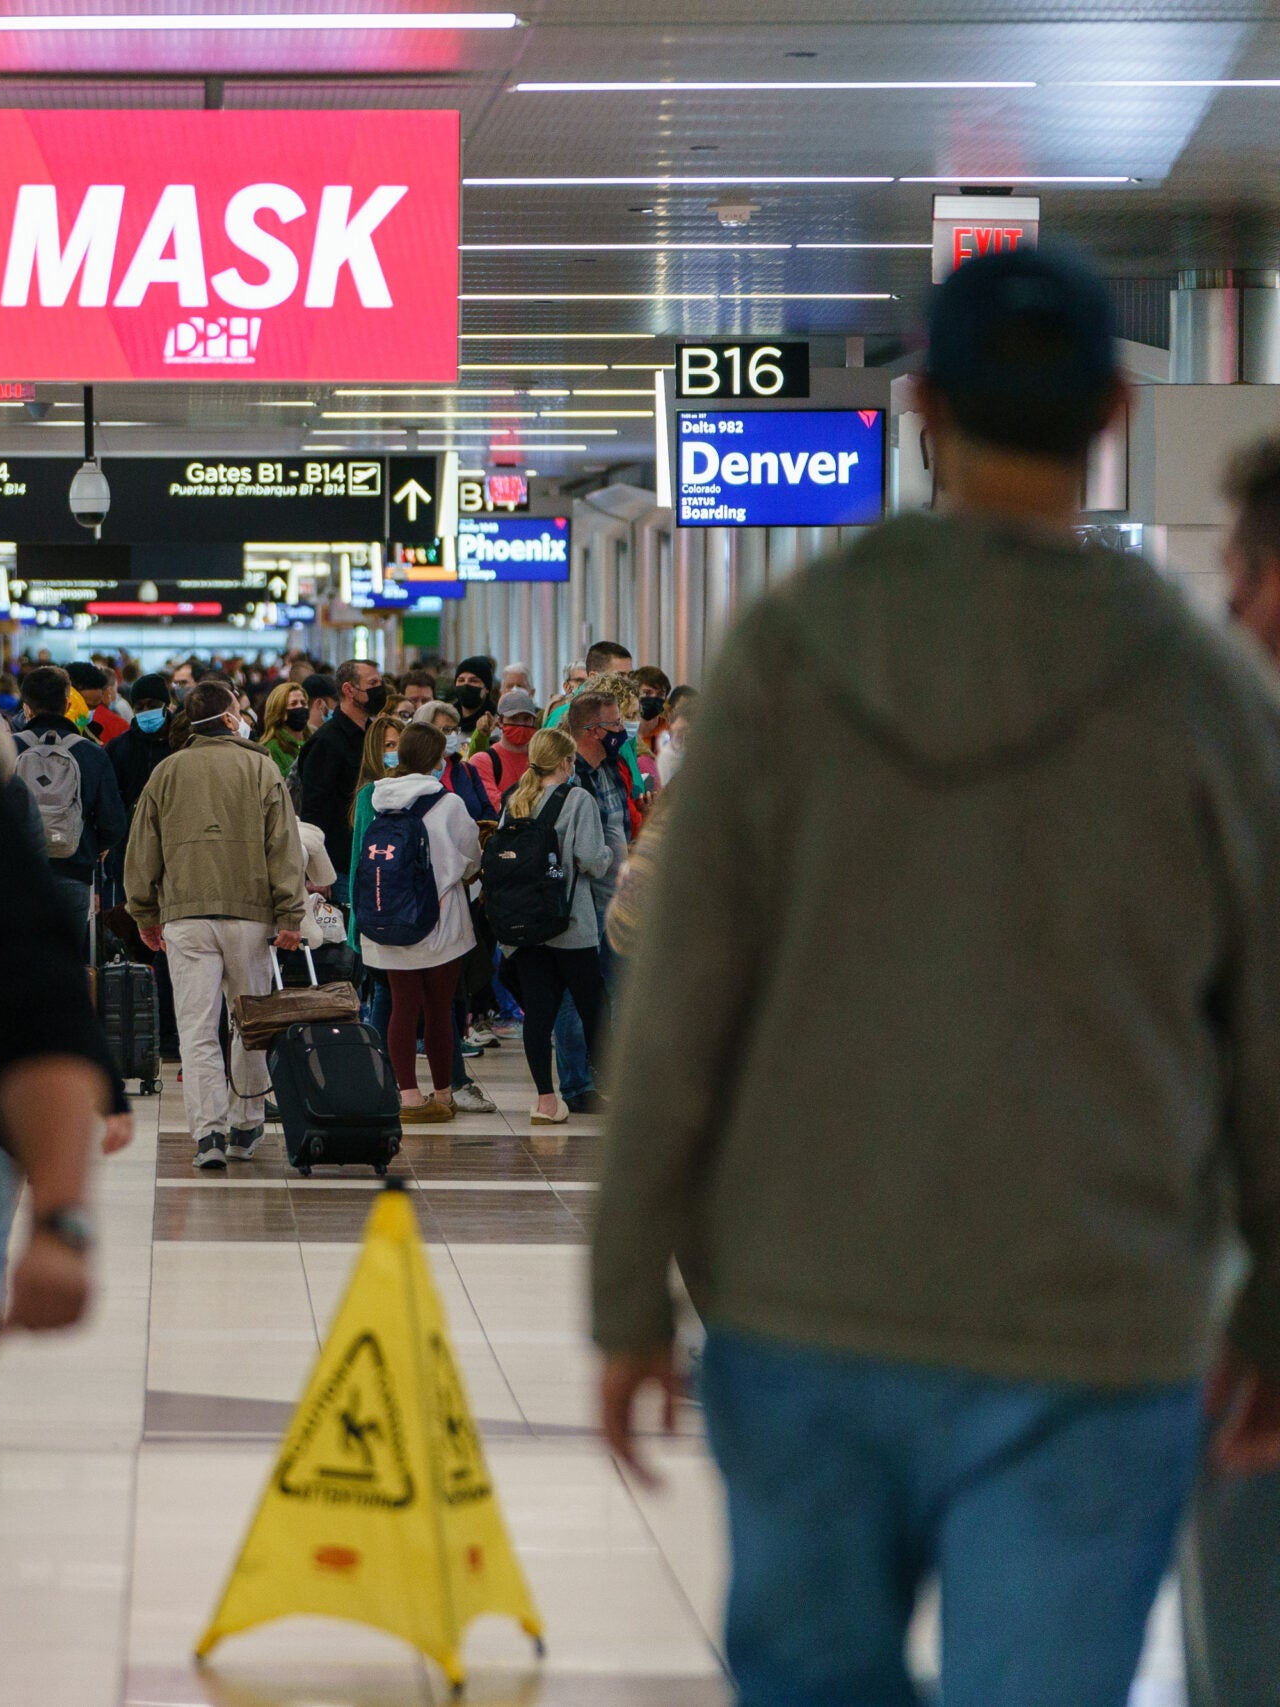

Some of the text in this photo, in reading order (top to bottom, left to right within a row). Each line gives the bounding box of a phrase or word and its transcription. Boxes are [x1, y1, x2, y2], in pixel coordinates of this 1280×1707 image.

[681, 346, 785, 396] B16
[681, 419, 745, 434] Delta 982
[681, 441, 860, 485] Denver
[186, 462, 253, 483] Gates
[259, 462, 284, 482] B1
[305, 462, 346, 483] B14
[4, 482, 27, 495] B14
[170, 483, 217, 496] Puertas
[219, 483, 235, 496] de
[236, 483, 298, 497] Embarque
[299, 483, 315, 496] B1
[325, 483, 346, 496] B14
[681, 484, 722, 494] Colorado
[681, 497, 716, 506] STATUS
[681, 504, 747, 522] Boarding
[458, 532, 567, 563] Phoenix
